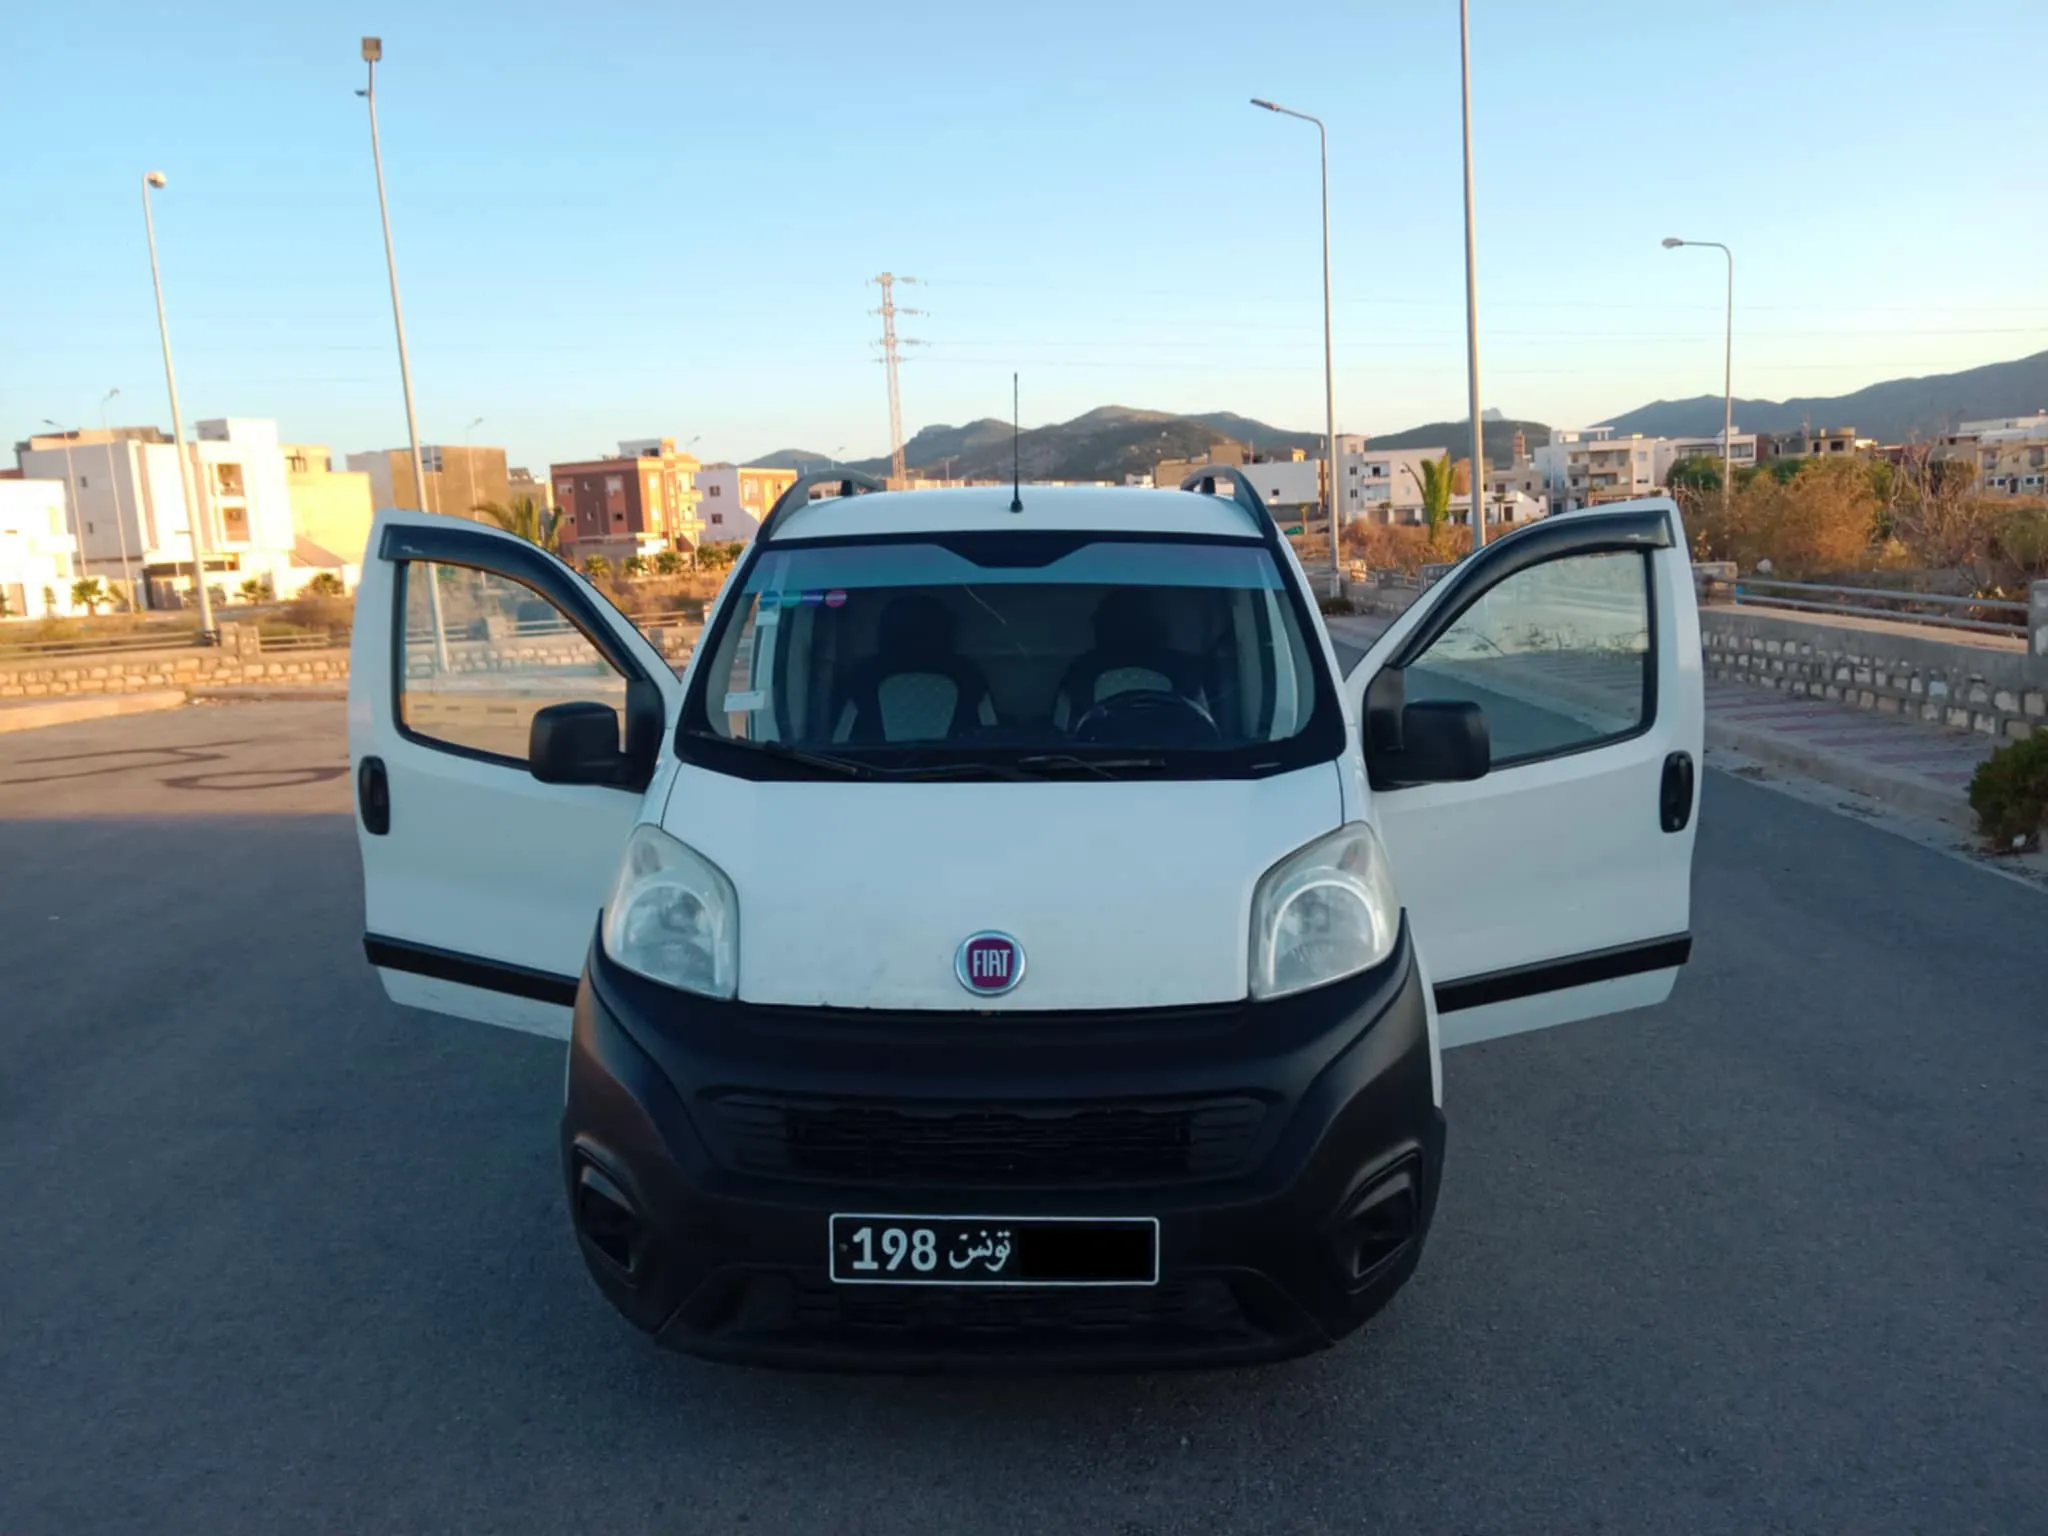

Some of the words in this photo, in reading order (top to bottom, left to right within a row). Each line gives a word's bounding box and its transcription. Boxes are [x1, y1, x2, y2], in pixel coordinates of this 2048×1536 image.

[972, 949, 1011, 977] FIAT
[852, 1227, 938, 1271] 198
[948, 1230, 1011, 1272] تونس
